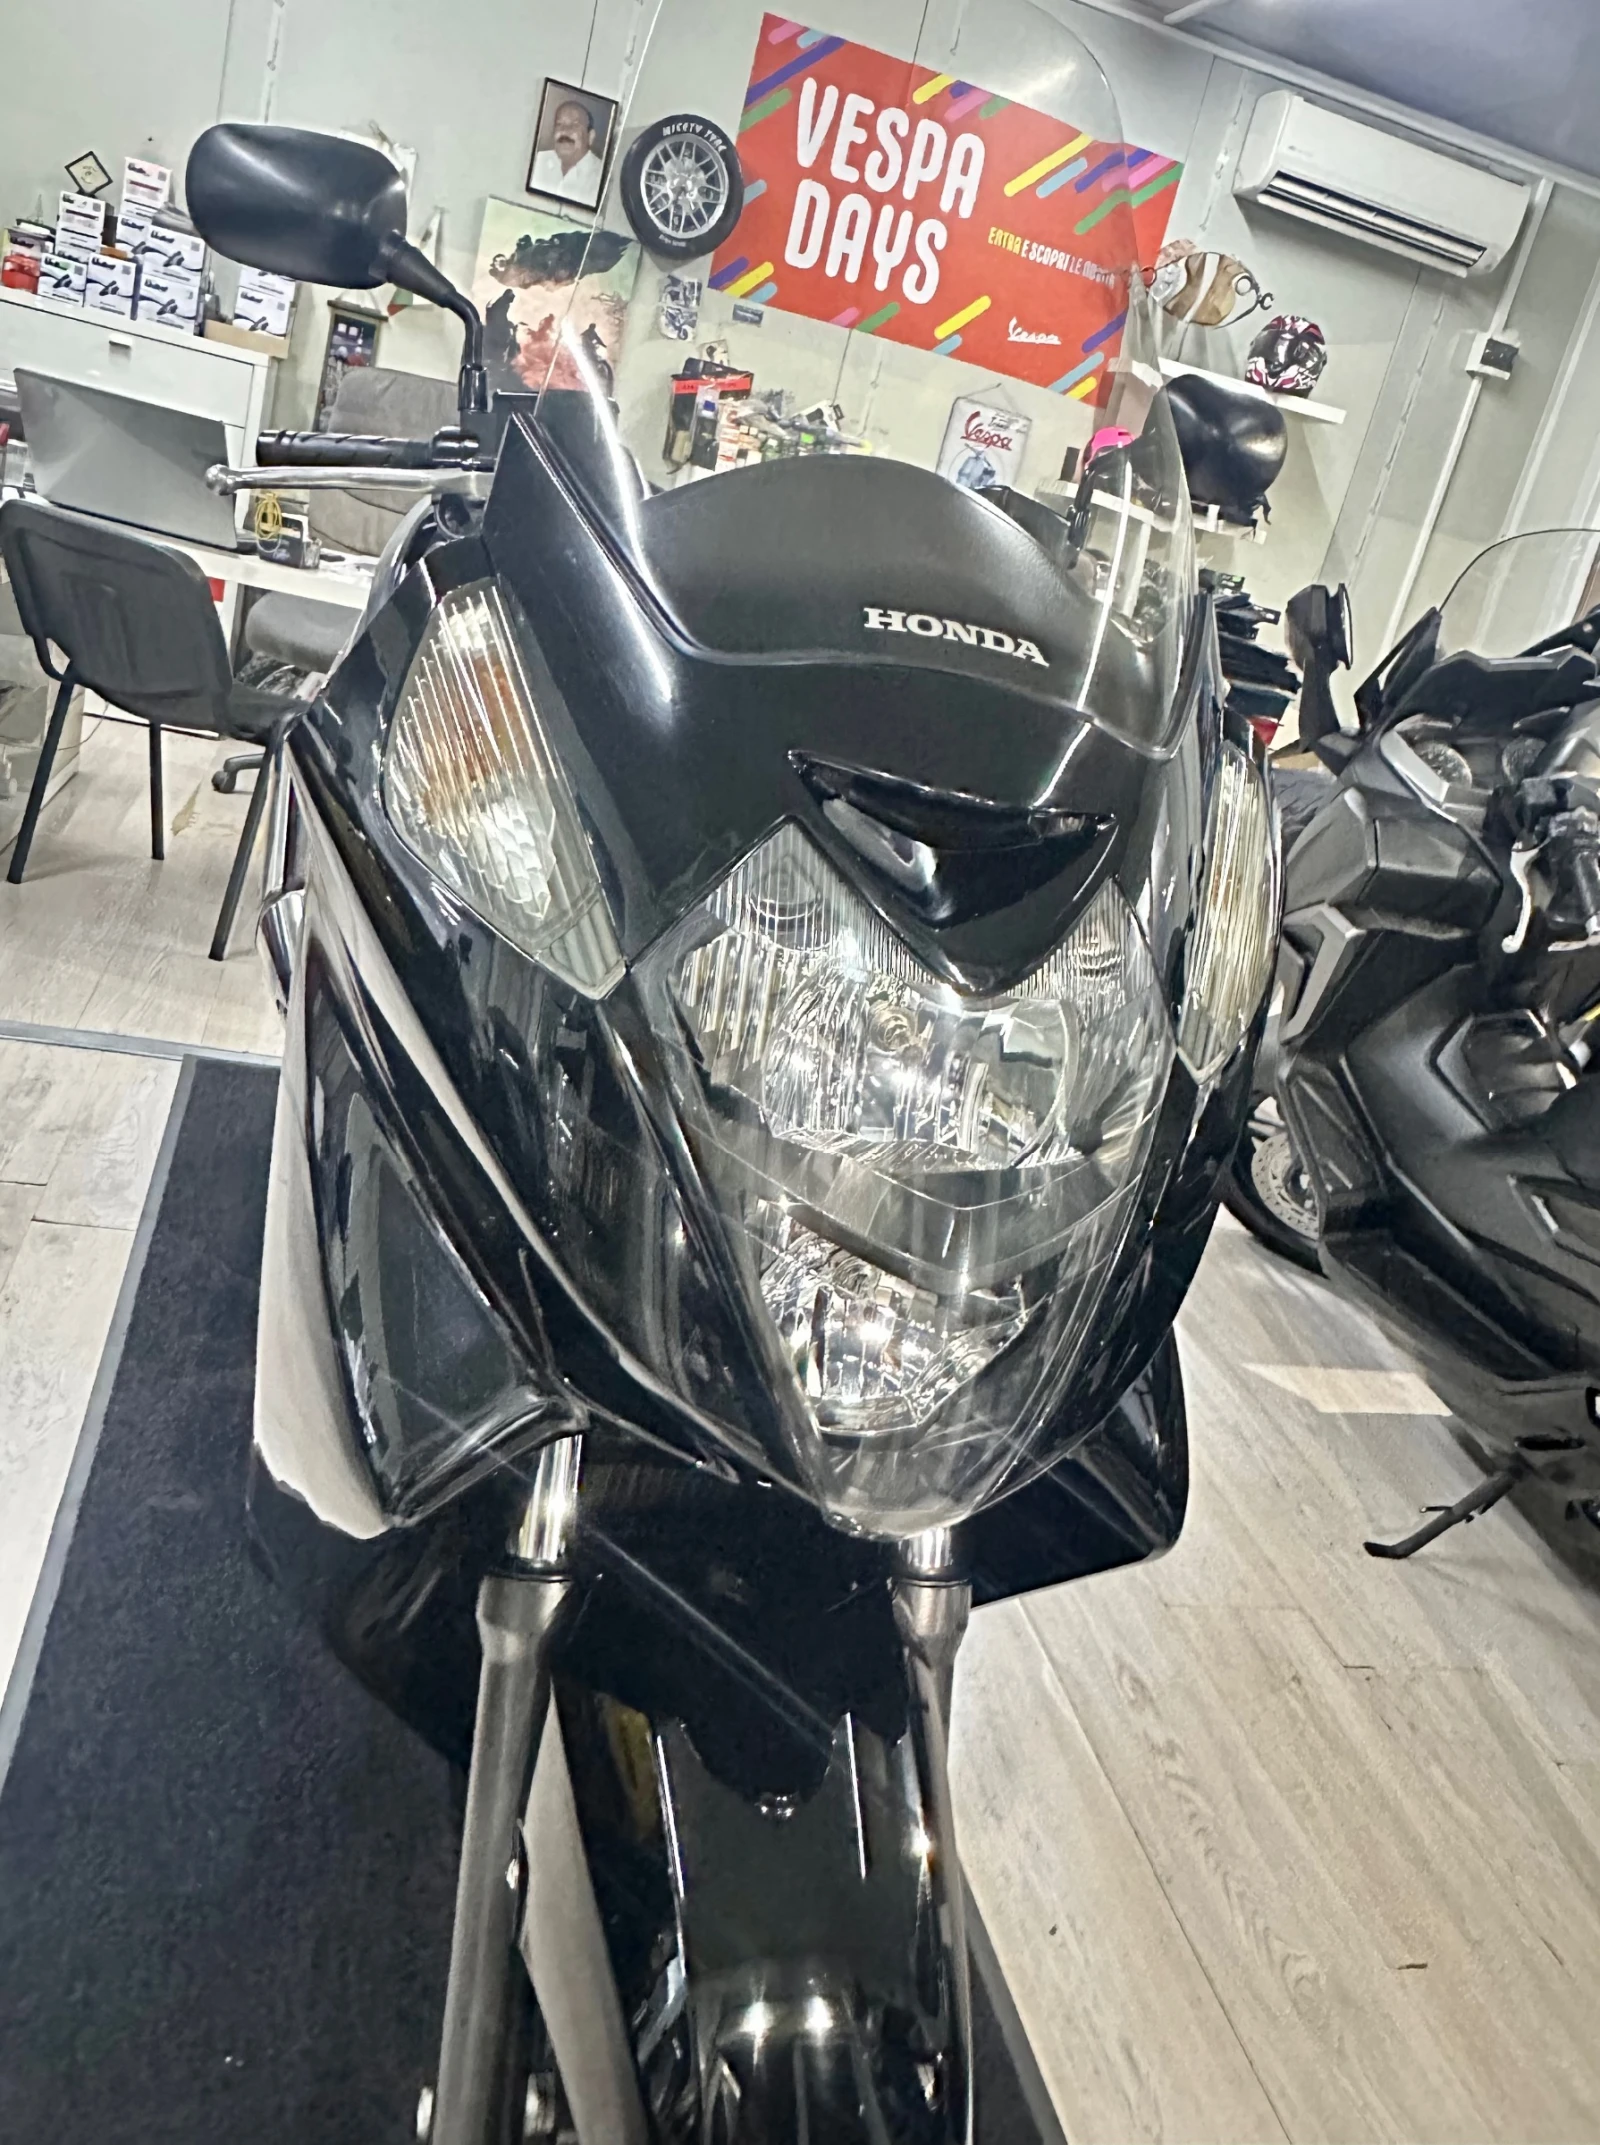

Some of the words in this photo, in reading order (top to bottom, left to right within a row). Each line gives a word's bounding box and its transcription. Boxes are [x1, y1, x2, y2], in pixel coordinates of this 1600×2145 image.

[797, 77, 986, 219] VESPA
[784, 179, 948, 304] DAYS
[1021, 239, 1030, 259] E
[1029, 241, 1071, 272] SCOPRI
[1007, 316, 1062, 345] Vespa
[960, 410, 1013, 451] Vespa
[863, 607, 1050, 668] HONDA
